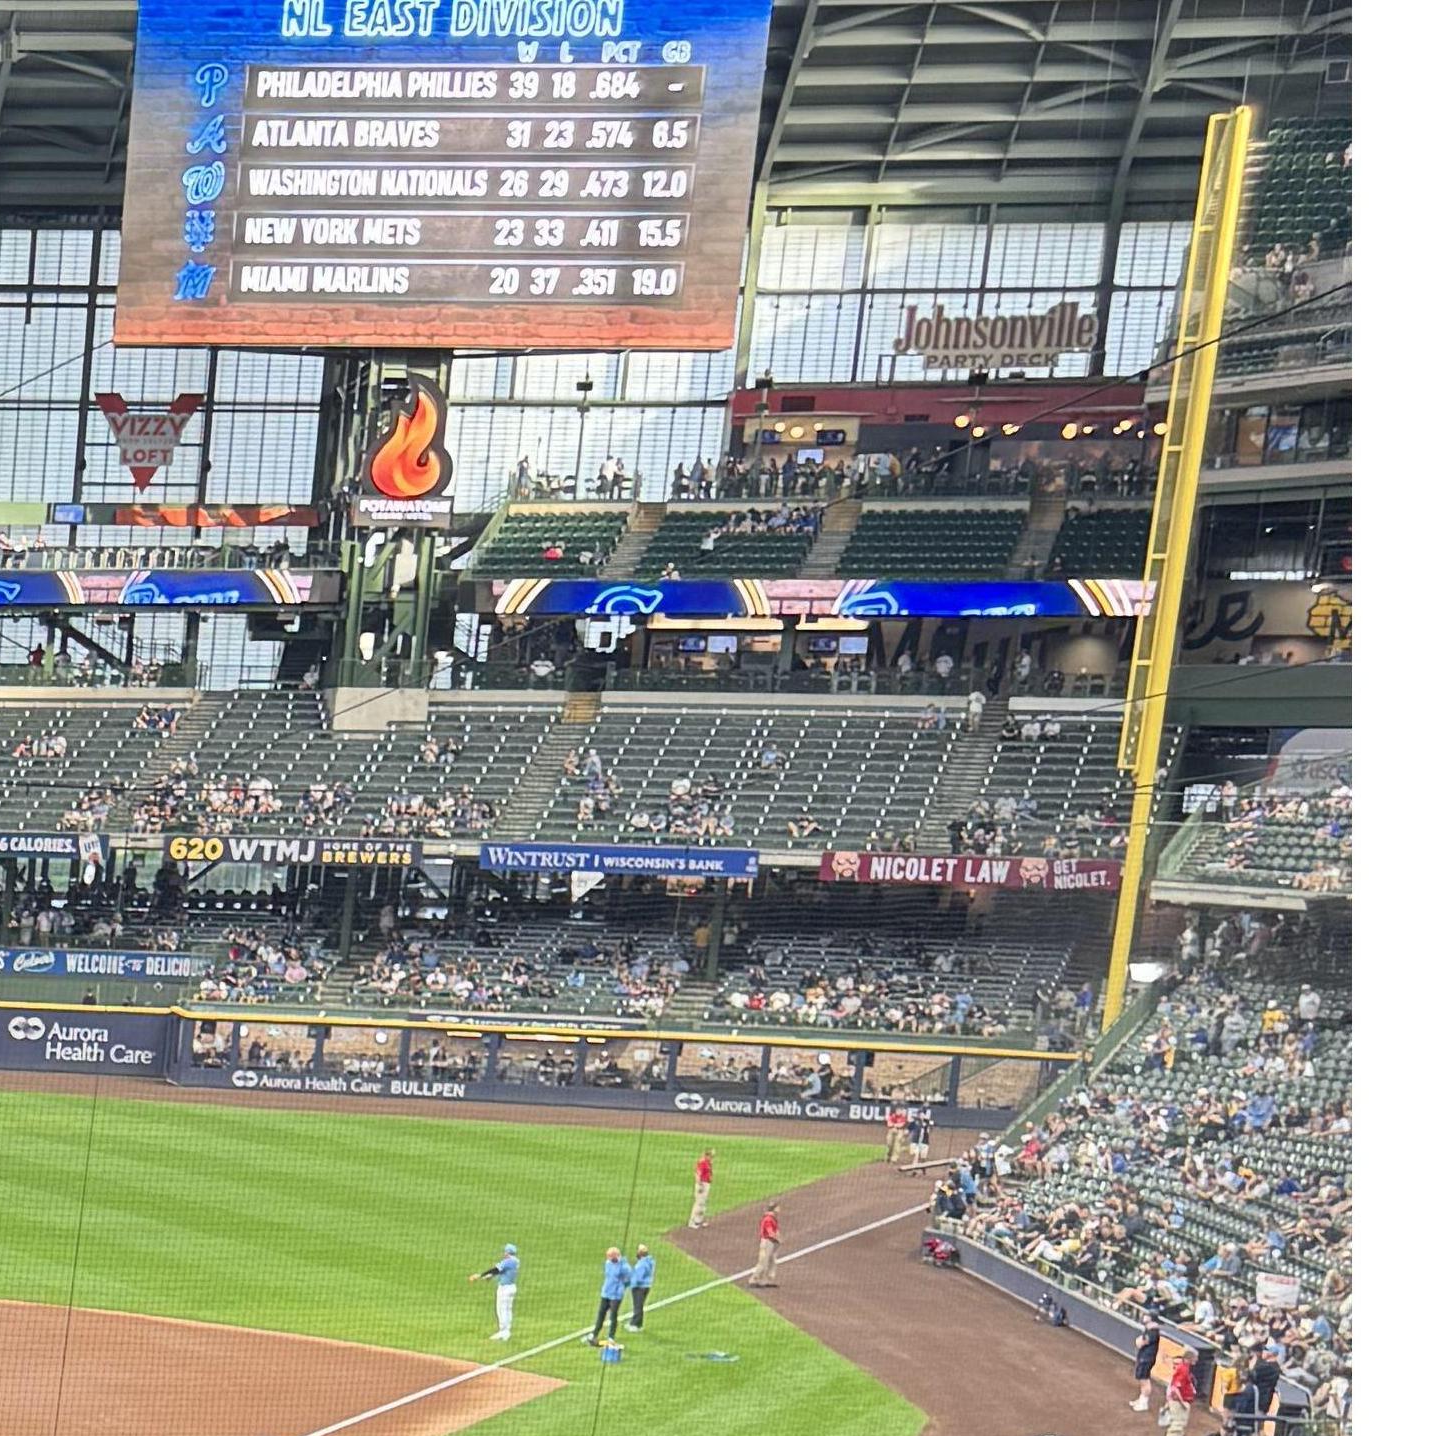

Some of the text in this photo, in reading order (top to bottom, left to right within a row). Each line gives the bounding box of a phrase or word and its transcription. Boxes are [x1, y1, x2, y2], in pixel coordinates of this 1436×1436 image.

[281, 0, 624, 37] NL EAST DIVISION
[517, 41, 574, 63] W L
[257, 70, 640, 99] PHILADELPHIA PHILLIES 39 18 .684
[251, 120, 634, 148] ATLANTA BRAVES 31 23 .574
[248, 168, 687, 198] WASHINGTON NATIONALS 26 29 12.0
[244, 218, 680, 247] NEW YORK METS 23 33 15.5
[240, 265, 677, 296] MIAMI MARLINS 20 37 .351 19.0
[894, 301, 1097, 353] Johnsonville
[928, 353, 1059, 368] PARTY DECK
[108, 415, 189, 435] VIZZY
[120, 450, 171, 464] LOFT
[169, 838, 316, 864] 620 WTMJ
[487, 846, 590, 868] WINTRUST
[870, 858, 1011, 884] NICOLET LAW
[66, 953, 126, 976] WELCOME
[48, 1021, 108, 1042] Aurora
[44, 1041, 153, 1064] Health Care
[260, 1075, 465, 1098] Aurora Health BULLPEN
[705, 1097, 799, 1117] Aurora Health
